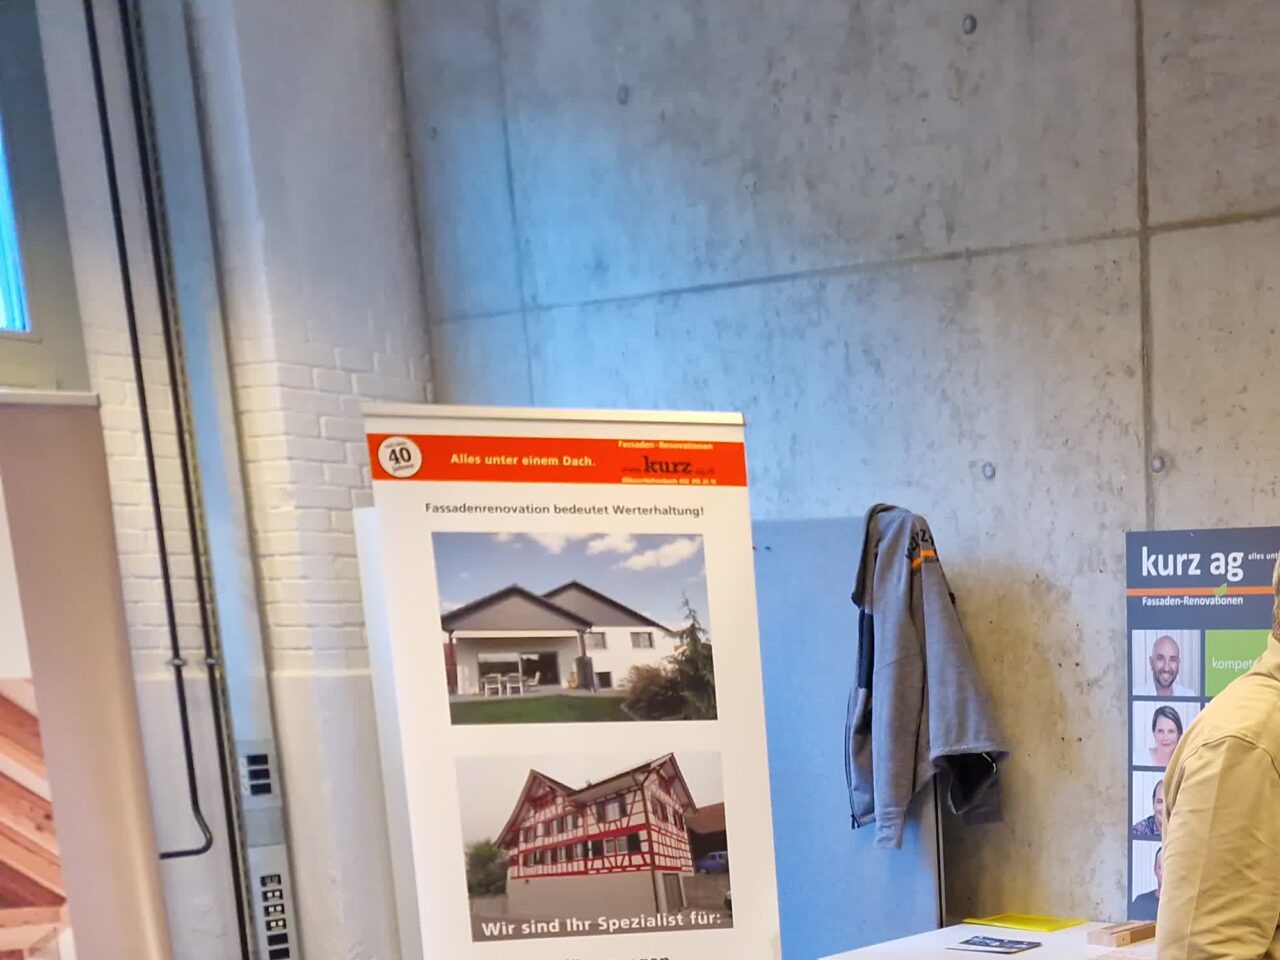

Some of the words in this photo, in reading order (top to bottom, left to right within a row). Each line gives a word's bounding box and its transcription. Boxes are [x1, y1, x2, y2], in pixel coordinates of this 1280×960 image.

[389, 447, 411, 465] 40
[451, 453, 481, 465] Alles
[485, 455, 518, 466] unter
[522, 455, 559, 466] einem
[563, 455, 596, 467] Dach.
[642, 455, 692, 474] kurz
[425, 503, 550, 515] Fassadenrenovation
[554, 504, 609, 515] bedeutet
[612, 504, 704, 518] Werterhaltung!
[1142, 546, 1201, 576] kurz
[1210, 552, 1244, 582] ag
[1142, 596, 1244, 606] Fassaden-Renovationen
[481, 921, 515, 936] Wir
[521, 919, 560, 934] sind
[566, 918, 591, 932] Ihr
[598, 913, 684, 932] Spezialist
[690, 911, 722, 926] für:
